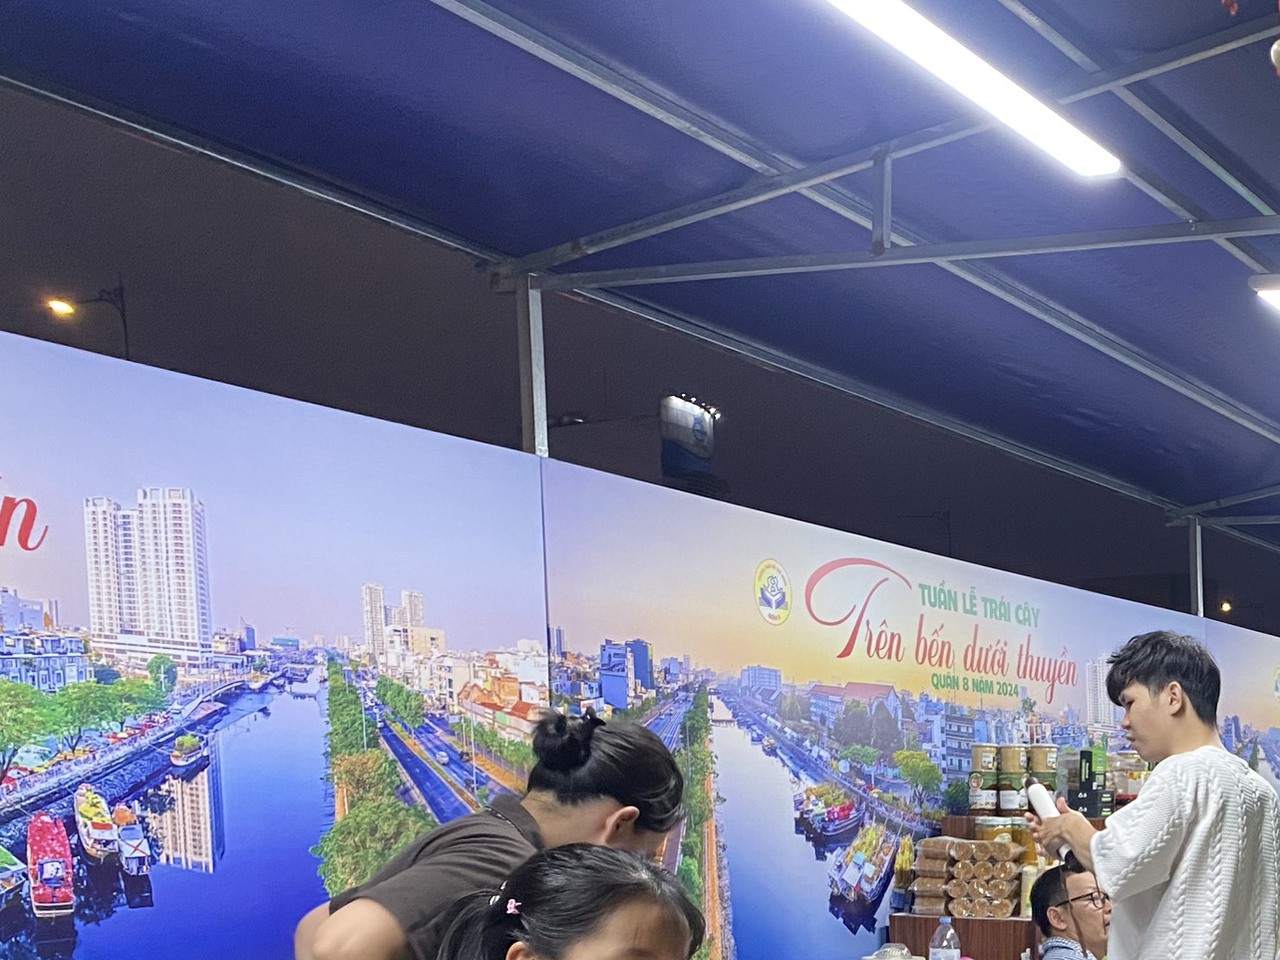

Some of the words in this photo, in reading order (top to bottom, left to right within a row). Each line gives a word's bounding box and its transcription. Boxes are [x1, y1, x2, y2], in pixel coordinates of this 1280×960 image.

[981, 595, 1011, 622] TRÁI
[1015, 601, 1040, 628] CÂY
[805, 557, 912, 663] Trên
[914, 613, 955, 669] bến
[963, 623, 1010, 677] dưới
[1017, 633, 1078, 704] thuyền
[962, 677, 969, 691] 8
[996, 681, 1020, 697] 2024
